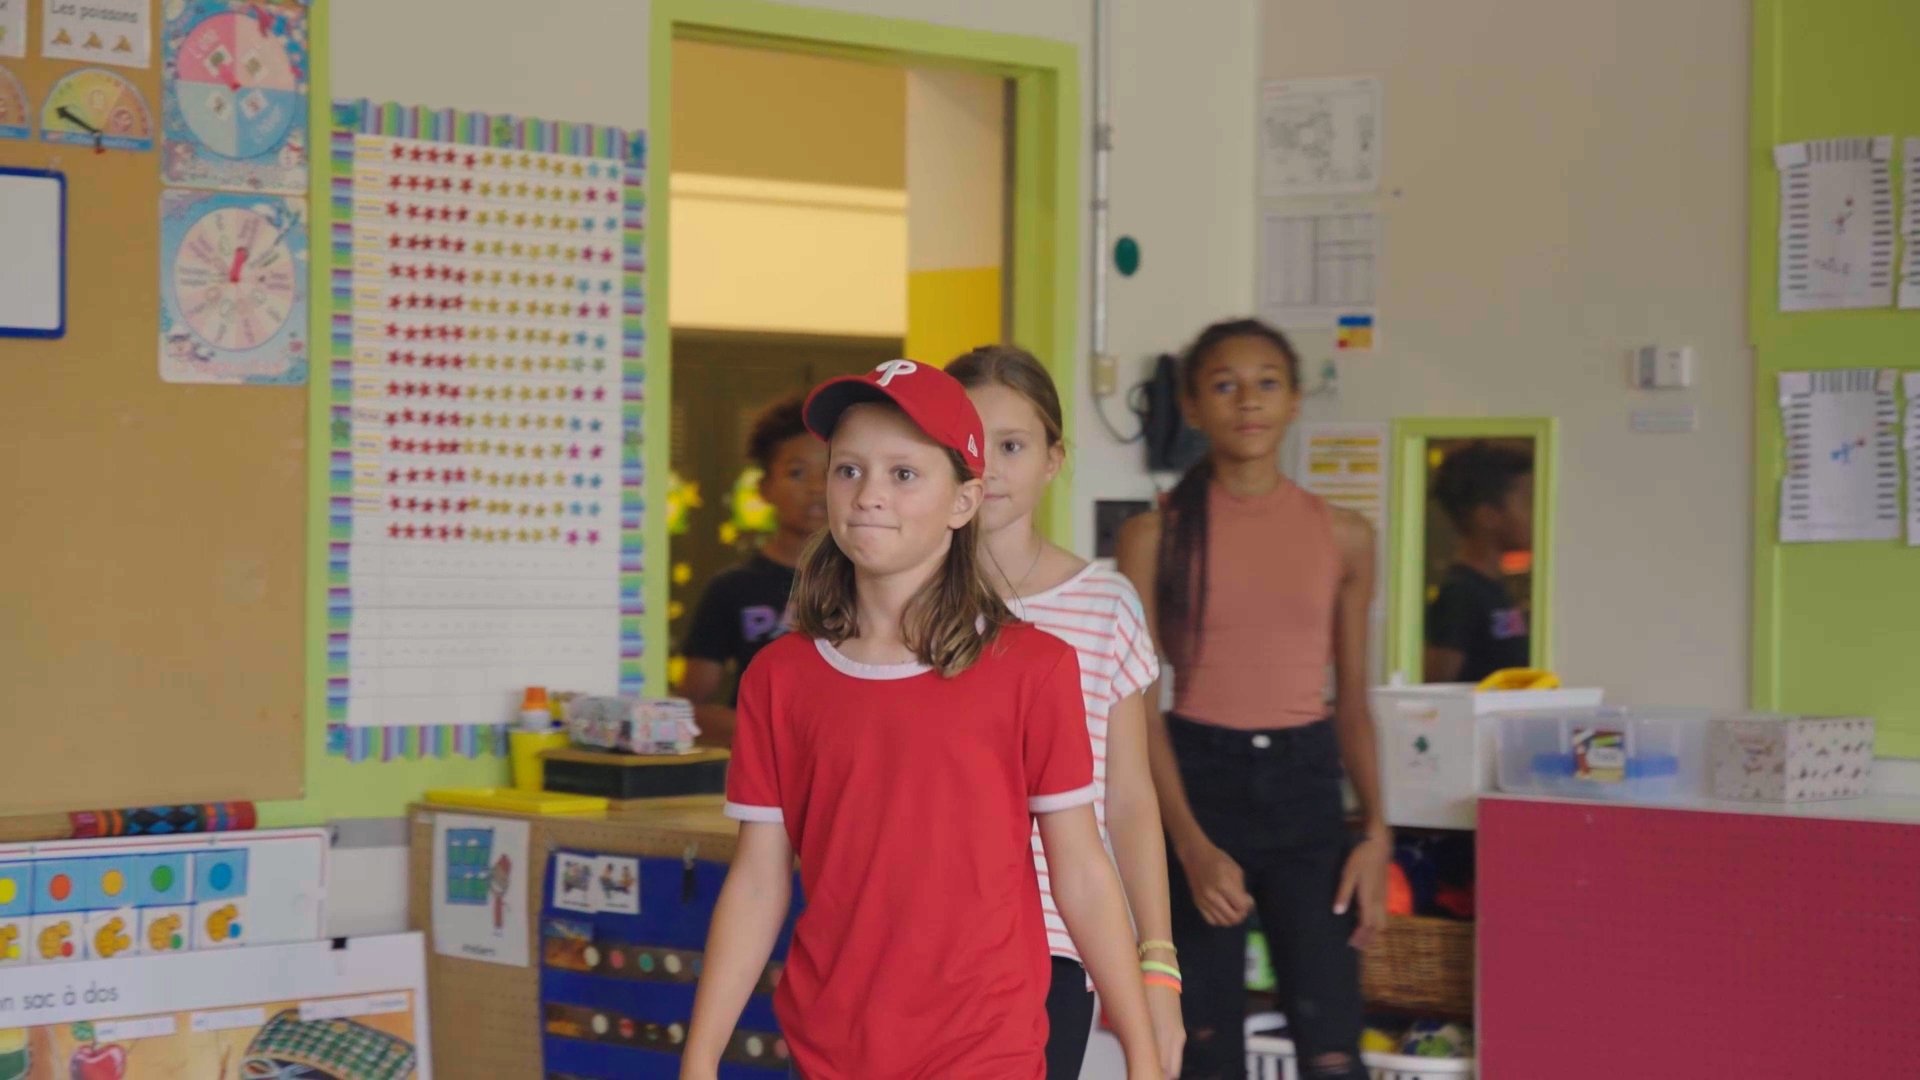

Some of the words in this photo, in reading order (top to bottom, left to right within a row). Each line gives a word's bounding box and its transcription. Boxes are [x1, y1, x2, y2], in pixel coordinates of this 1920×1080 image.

[51, 0, 76, 15] Les
[875, 359, 917, 387] P
[23, 992, 56, 1011] sac
[62, 984, 76, 1007] à
[83, 980, 118, 1004] dos
